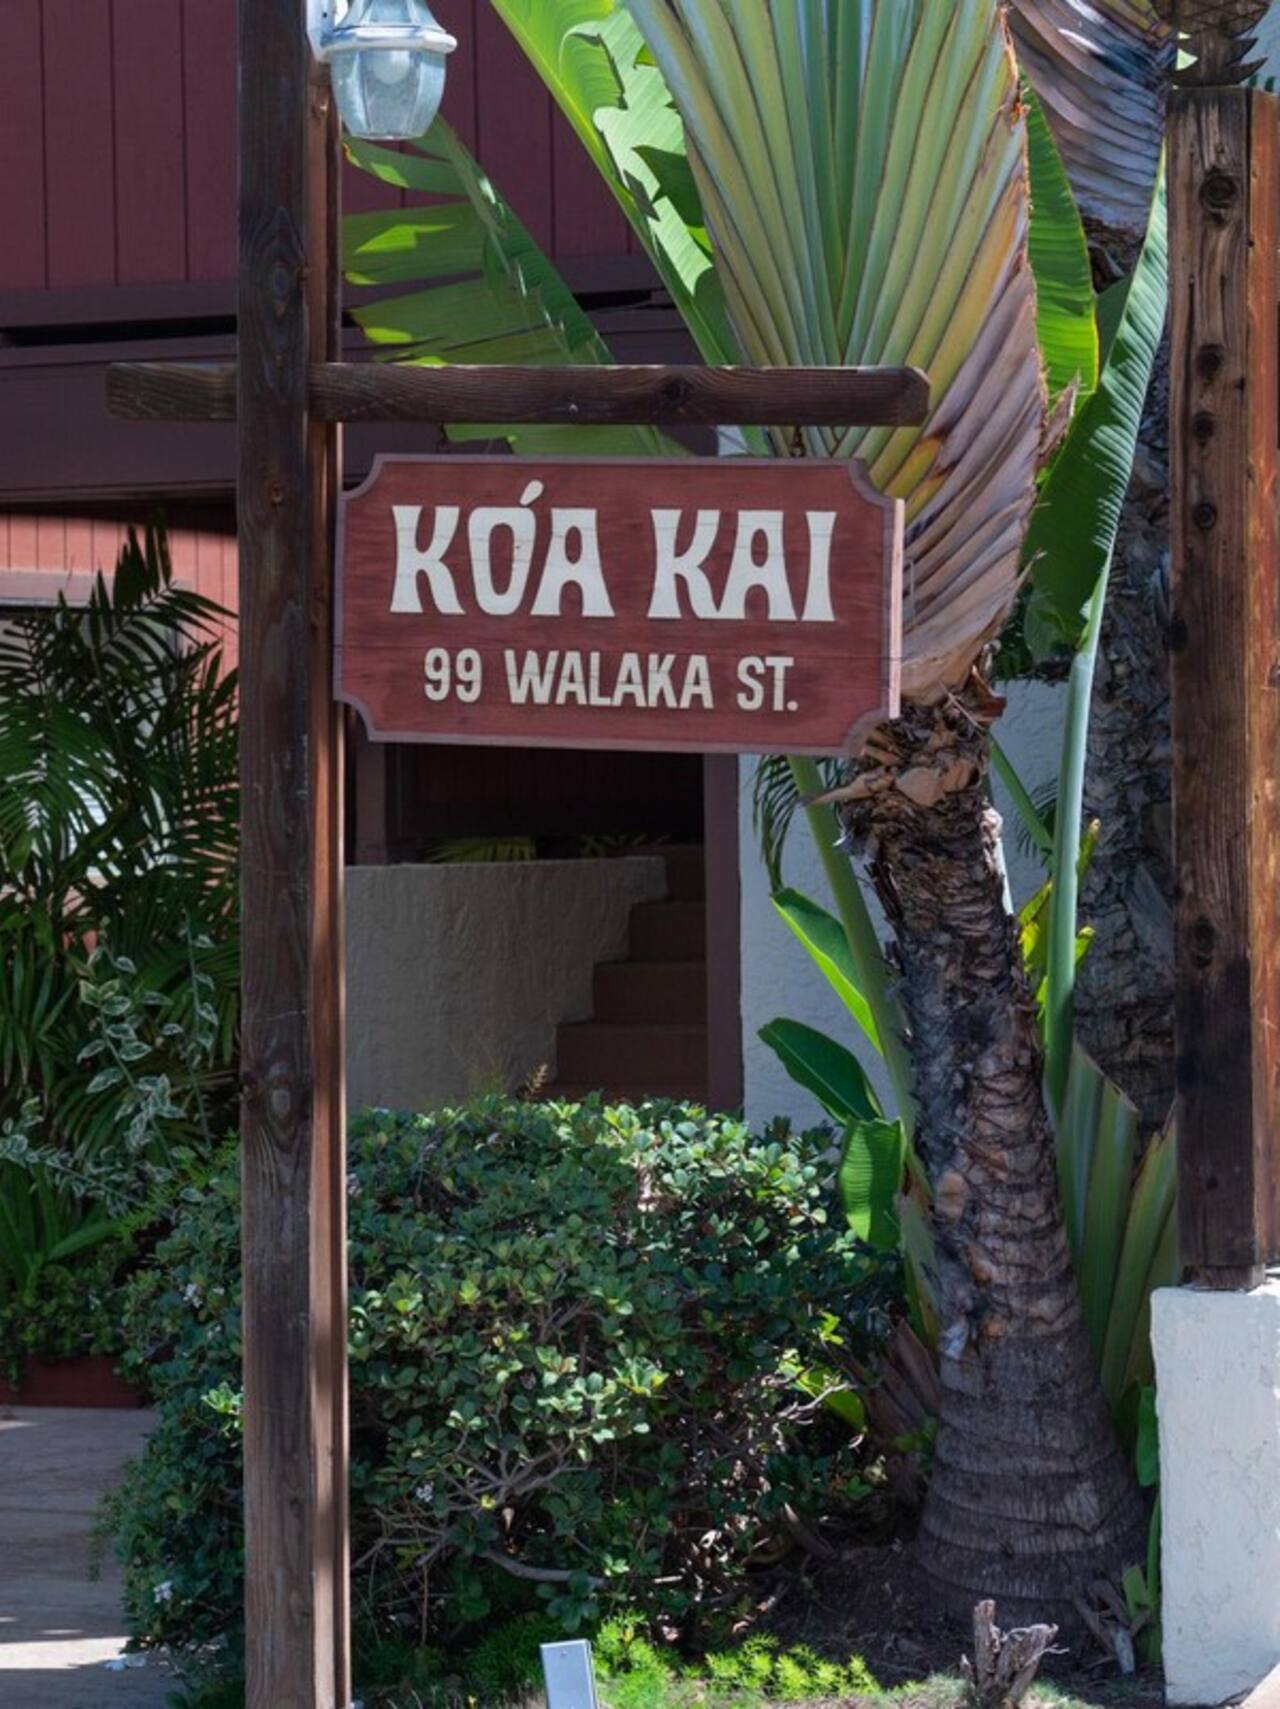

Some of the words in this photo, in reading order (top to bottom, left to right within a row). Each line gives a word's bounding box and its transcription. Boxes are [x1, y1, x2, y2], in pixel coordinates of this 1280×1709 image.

[647, 509, 837, 622] KAI
[424, 647, 482, 702] 99
[504, 649, 713, 709] WALAKA
[736, 656, 799, 712] ST.
